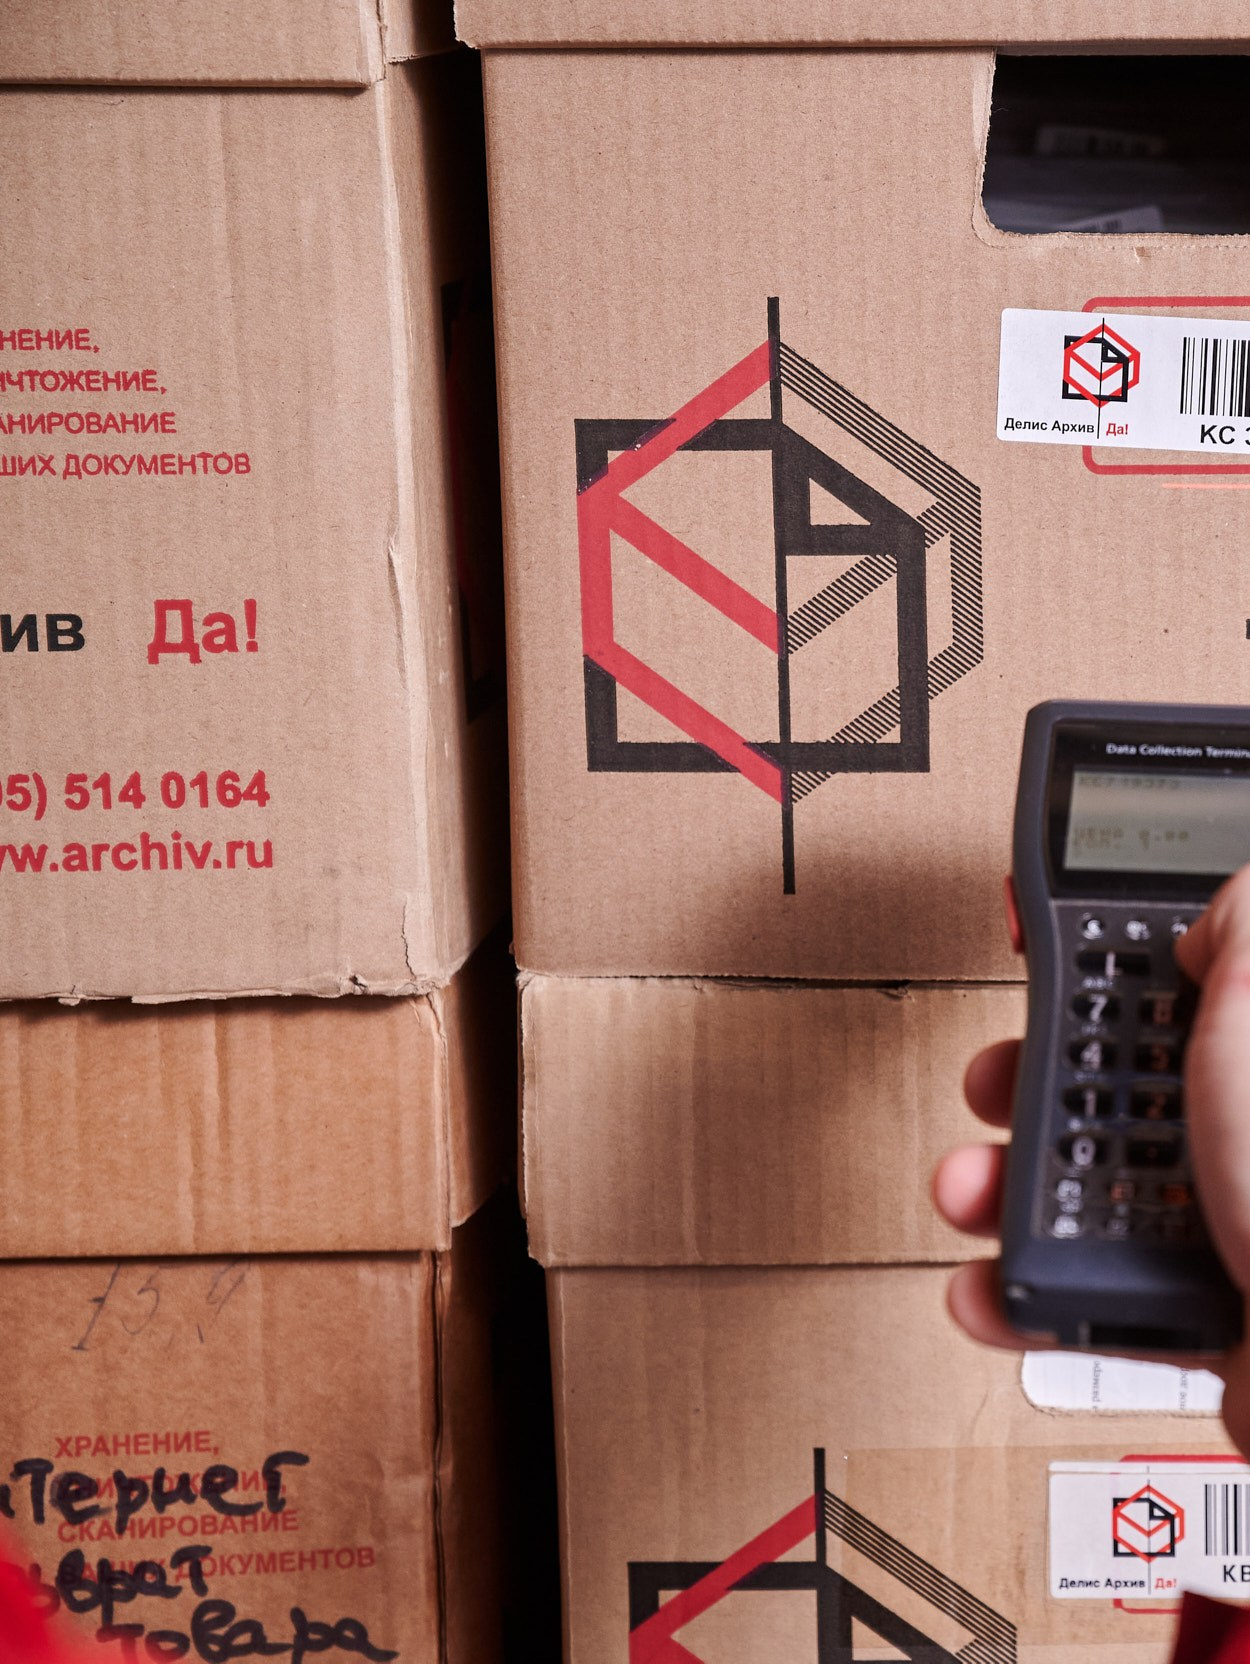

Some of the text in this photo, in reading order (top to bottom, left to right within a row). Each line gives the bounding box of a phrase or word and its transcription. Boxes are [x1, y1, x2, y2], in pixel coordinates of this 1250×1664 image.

[1004, 417, 1129, 436] Делис Архив Да!
[63, 452, 251, 479] ДОКУМЕНТОВ
[147, 599, 259, 665] Да!
[1105, 743, 1137, 755] Data
[1139, 744, 1203, 757] Collection
[0, 770, 270, 821] 5) 514 0164
[55, 1430, 220, 1458] ХРАНЕНИЕ,
[1059, 1578, 1178, 1589] Делис Архив Да!
